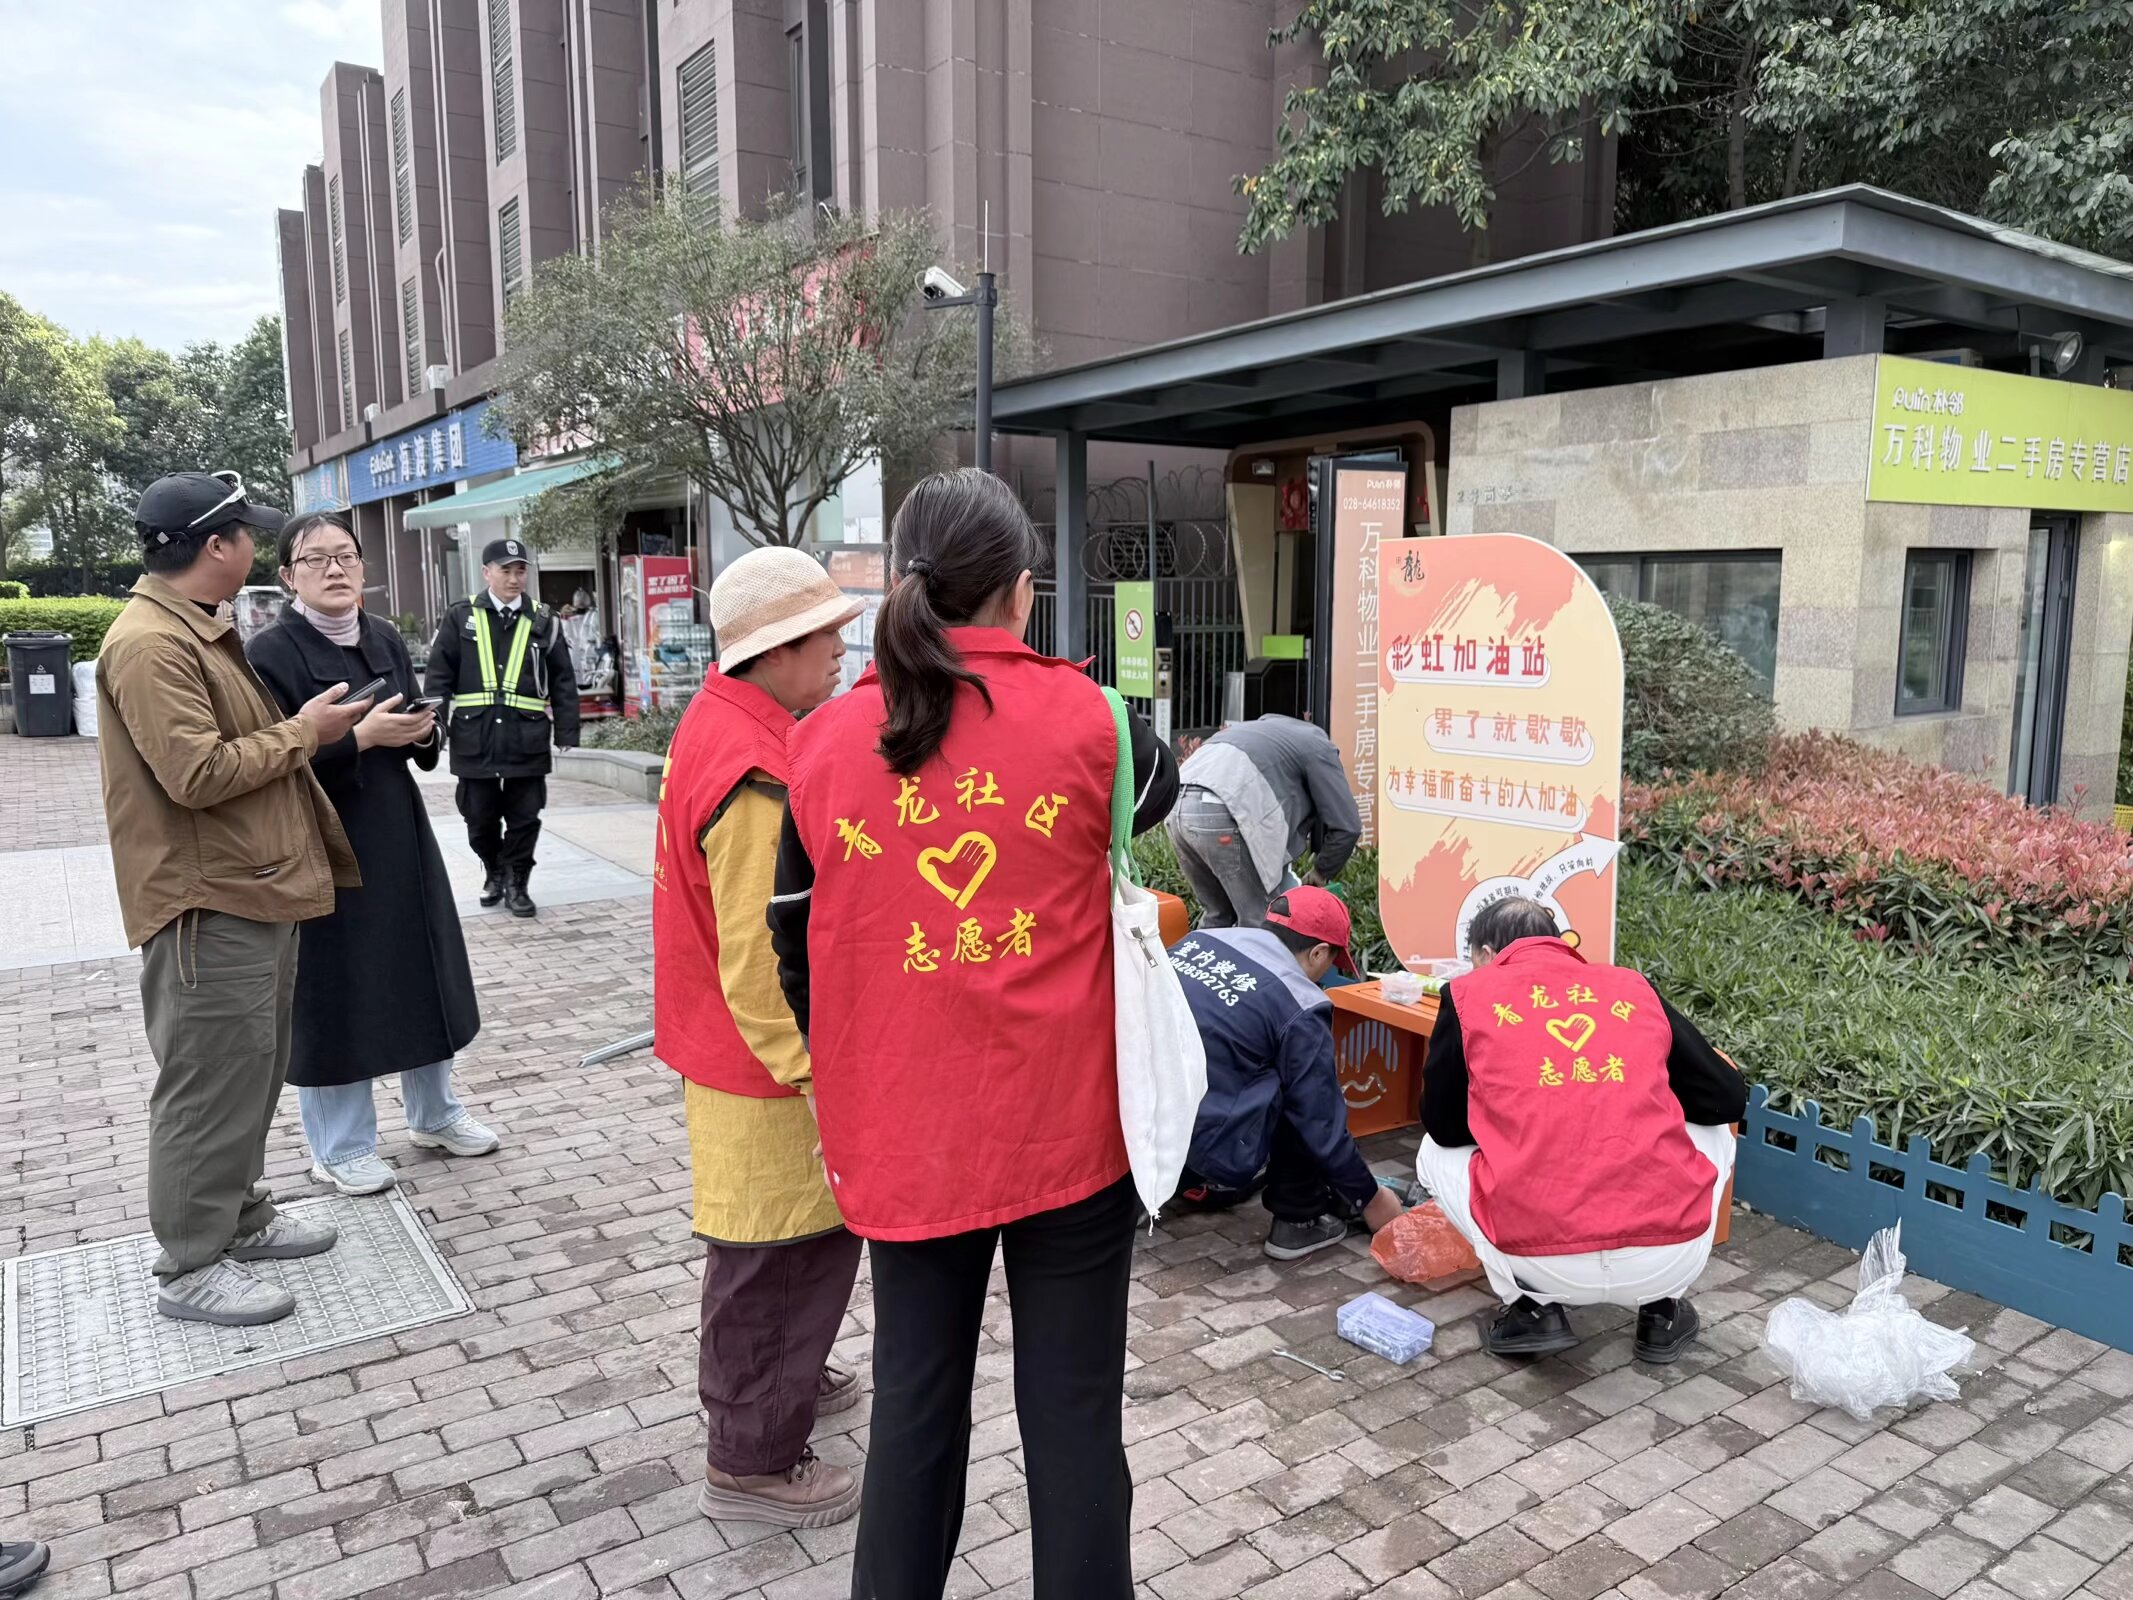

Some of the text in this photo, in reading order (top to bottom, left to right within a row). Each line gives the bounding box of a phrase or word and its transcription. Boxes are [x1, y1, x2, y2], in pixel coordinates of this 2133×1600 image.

[1933, 390, 1964, 415] 朴邻
[1882, 423, 2131, 484] 万科物业二手房专营店
[1343, 496, 1400, 511] 028-64618352
[1391, 634, 1545, 676] 彩虹加油站
[1434, 707, 1586, 748] 累了就歇歇
[1388, 764, 1578, 817] 为幸福而奋斗的人加油
[902, 907, 1038, 975] 志愿者
[1174, 940, 1258, 993] 室内装修
[1492, 984, 1638, 1029] 青龙社区
[1537, 1053, 1626, 1088] 志愿者
